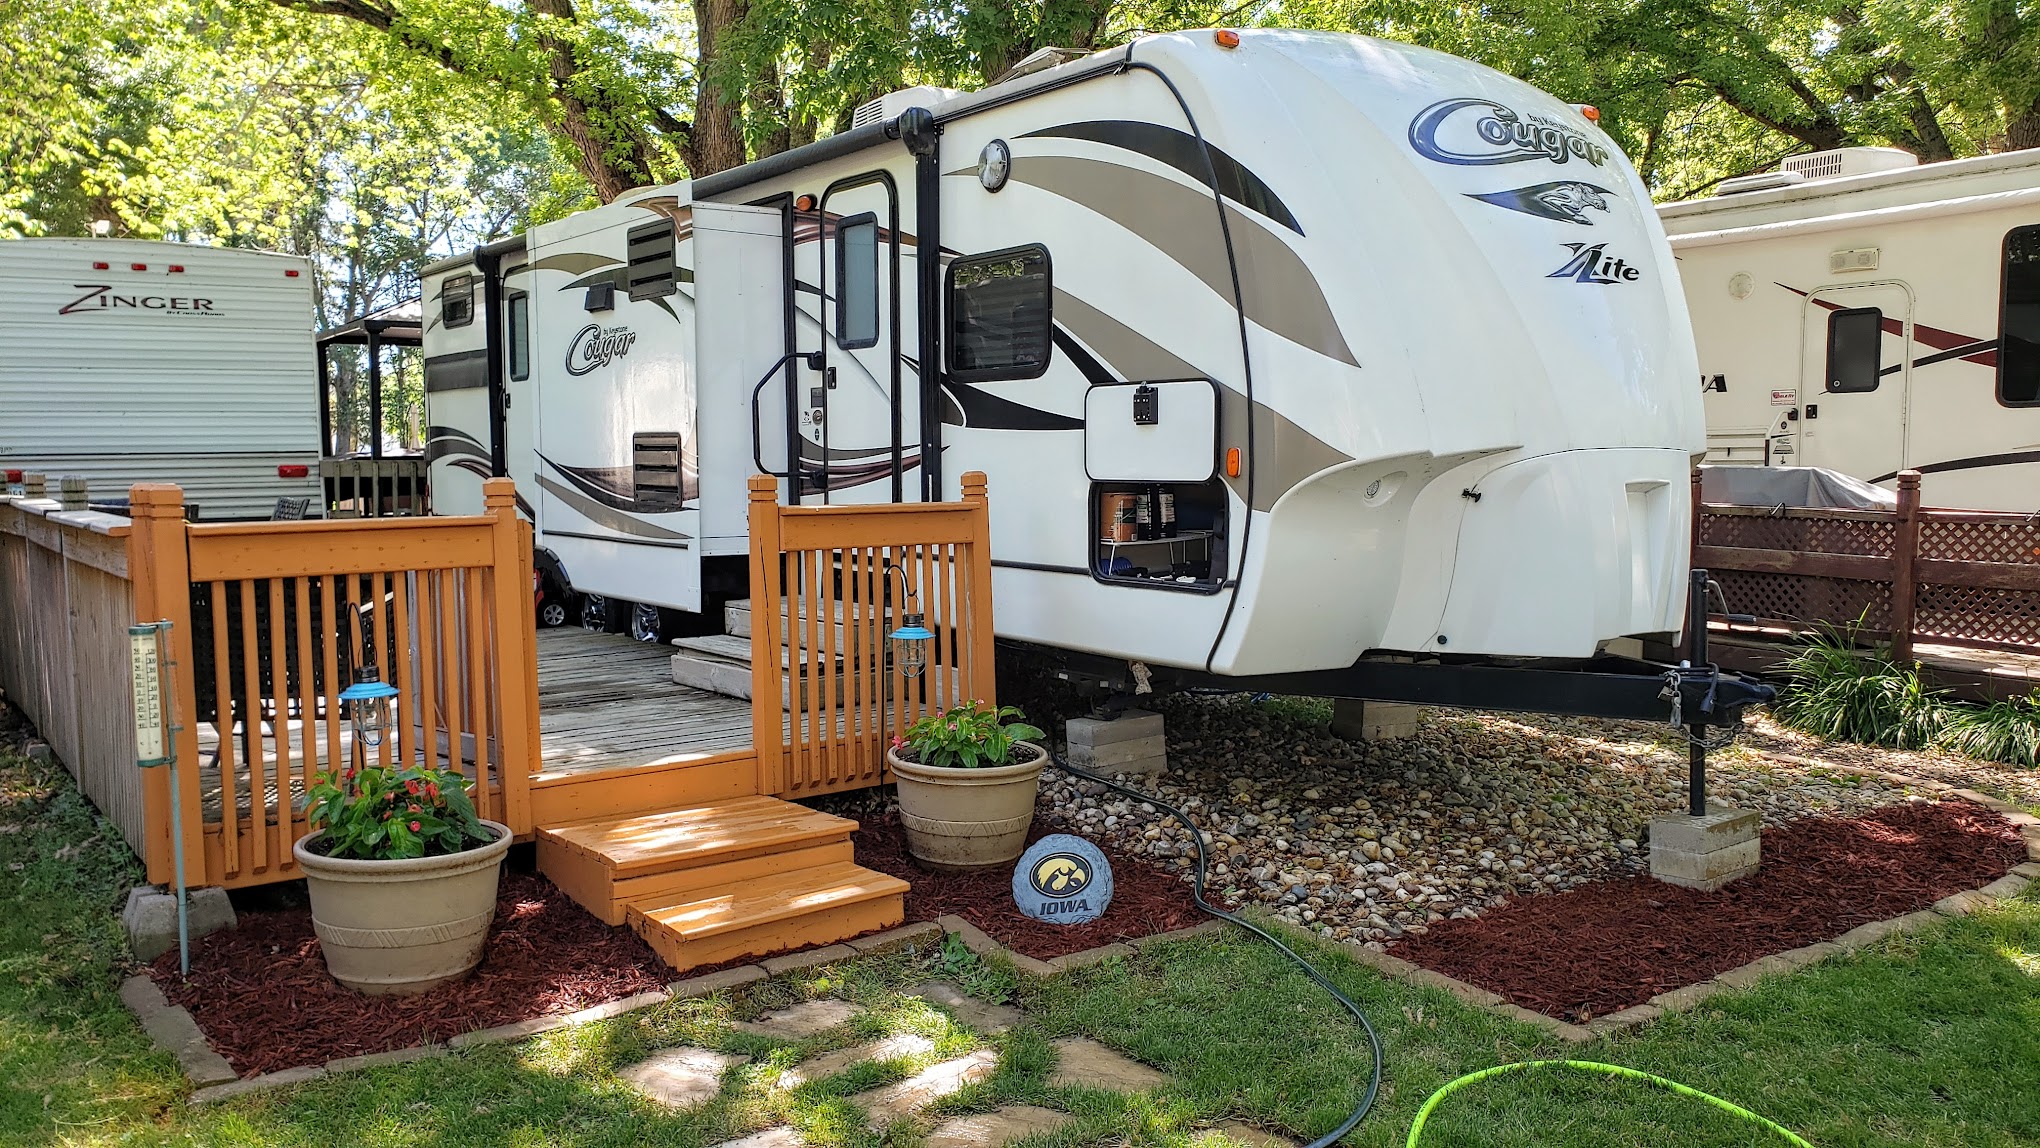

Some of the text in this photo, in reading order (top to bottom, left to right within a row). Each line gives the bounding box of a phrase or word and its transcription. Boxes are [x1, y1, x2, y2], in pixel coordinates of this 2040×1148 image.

[1408, 97, 1609, 168] Cougar
[1527, 112, 1544, 126] by
[58, 284, 214, 315] ZINGER
[565, 323, 636, 377] Cougar
[1039, 899, 1092, 916] IOWA
